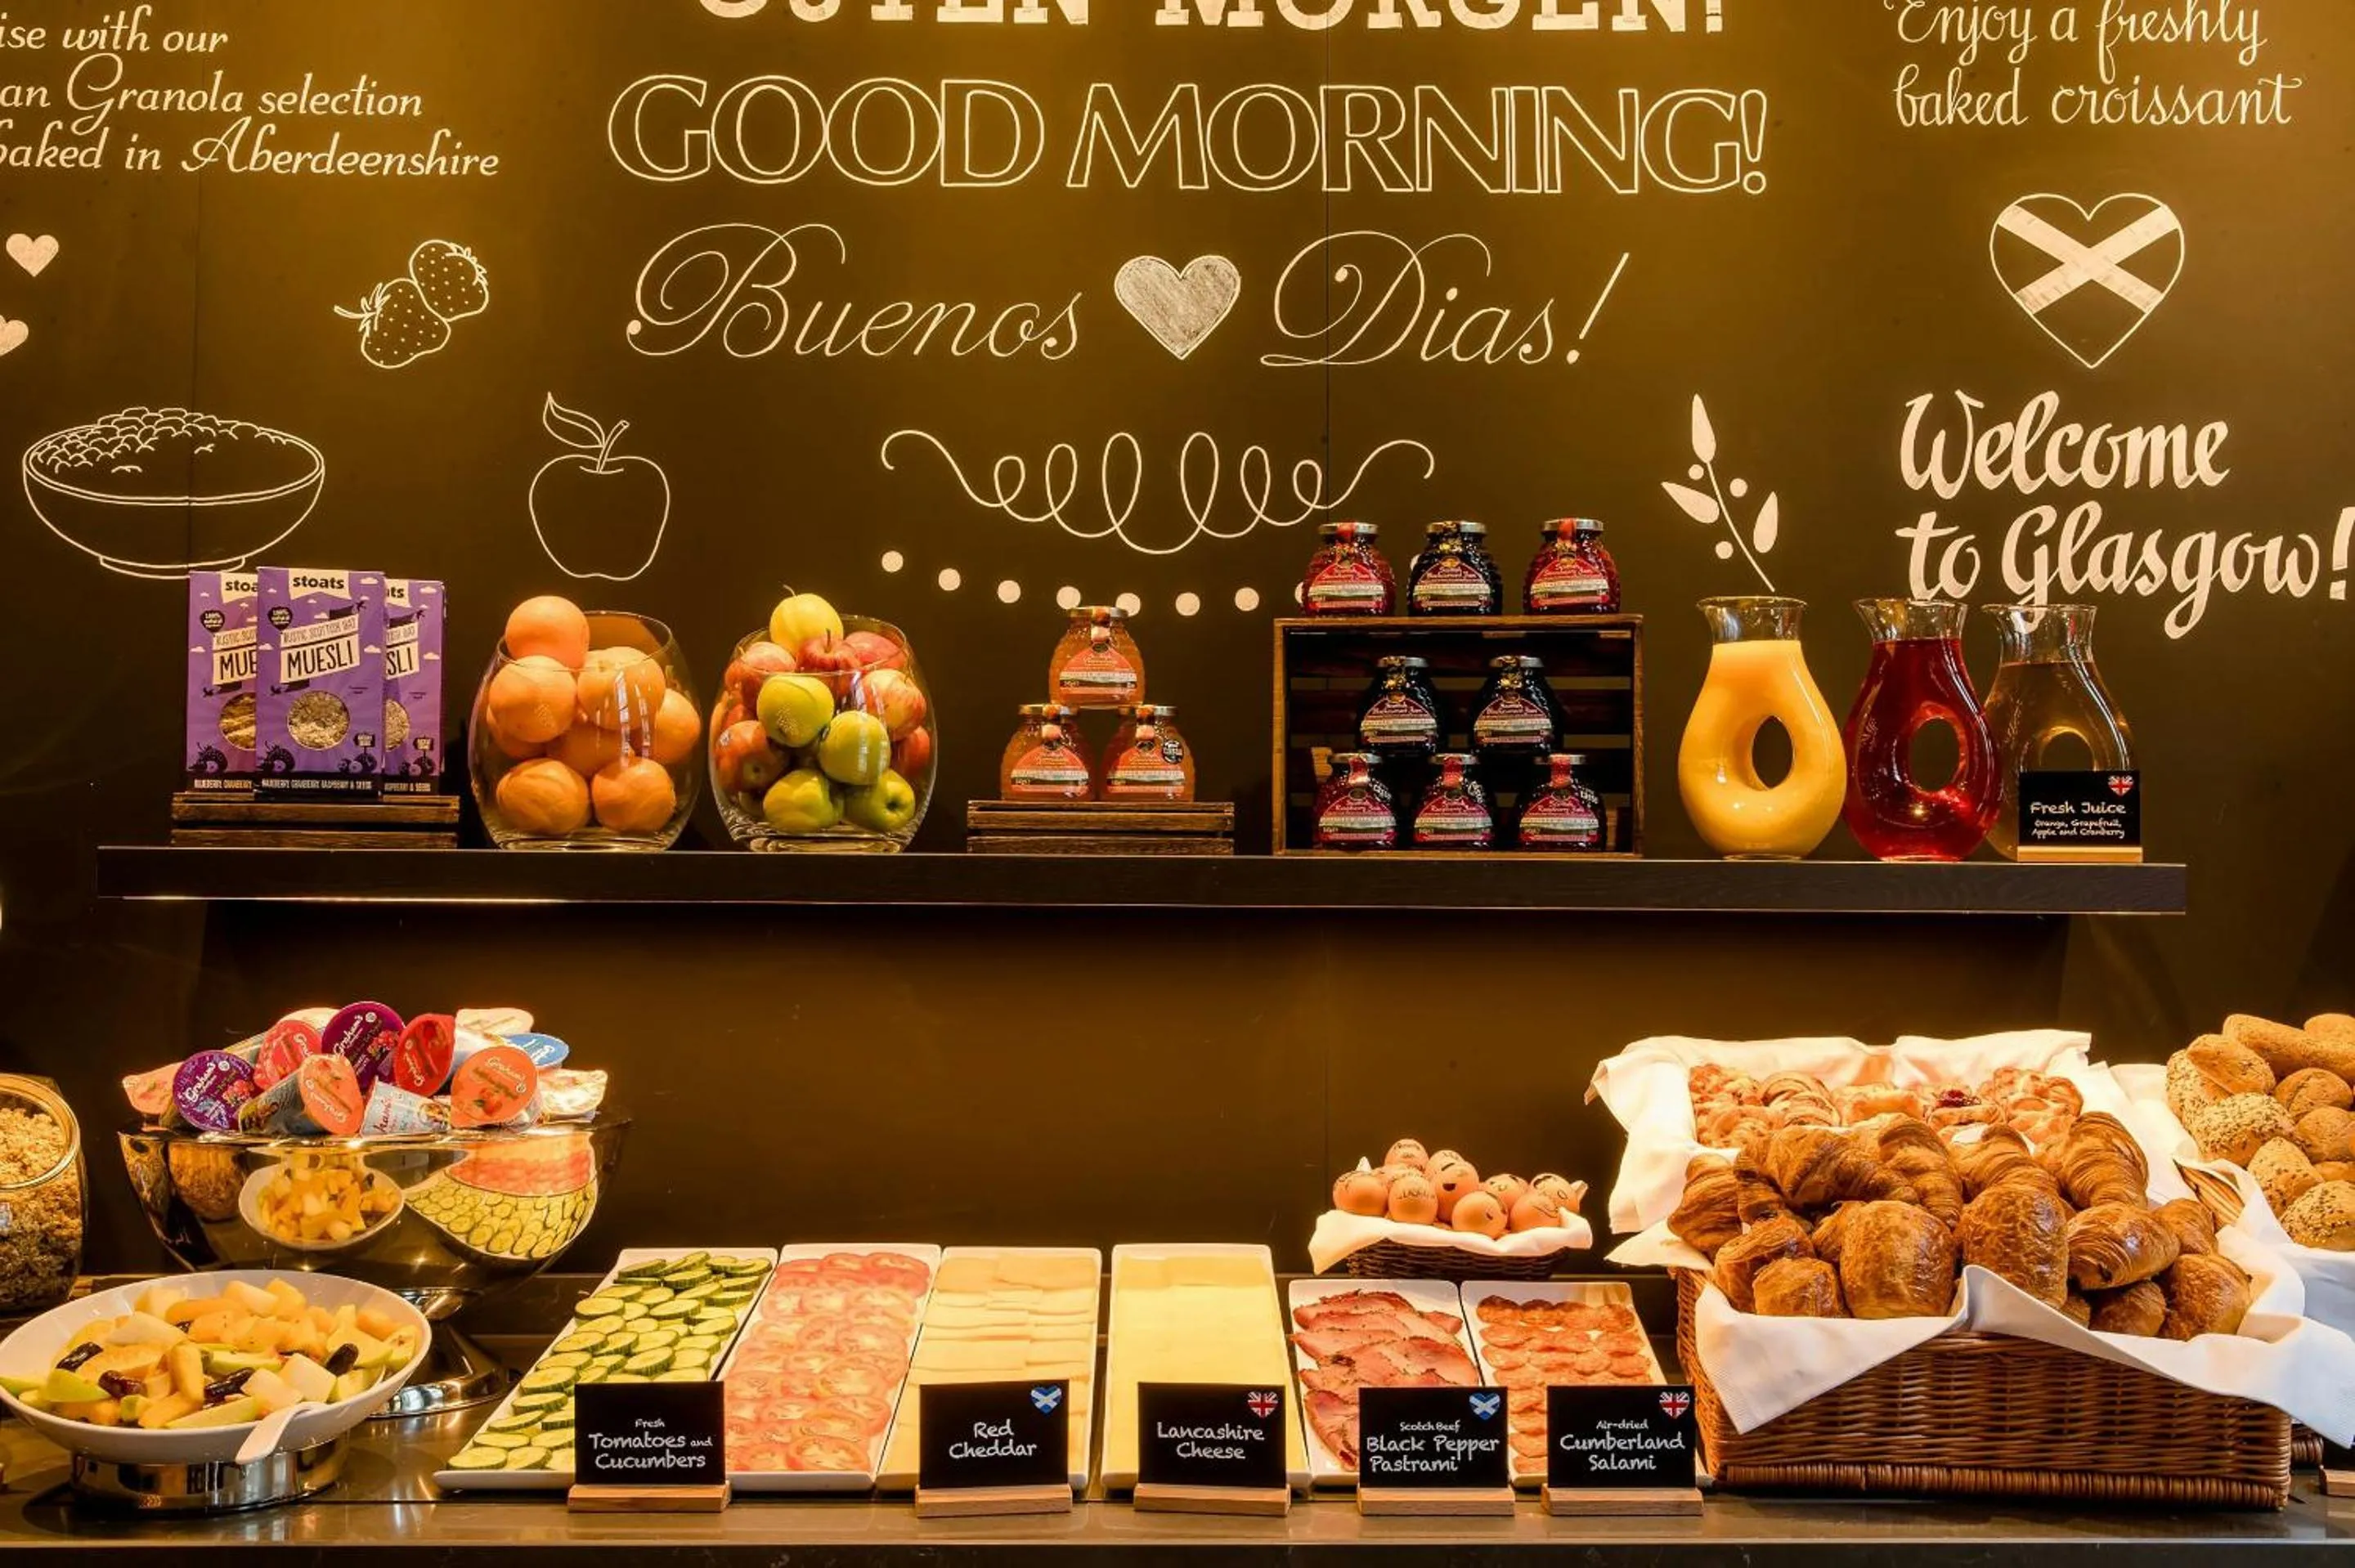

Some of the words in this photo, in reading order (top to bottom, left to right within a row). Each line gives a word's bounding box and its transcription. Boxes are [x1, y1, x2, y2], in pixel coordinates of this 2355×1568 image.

[62, 4, 153, 52] with
[163, 31, 228, 52] our
[1884, 0, 2037, 66] Enjoy
[2049, 2, 2078, 42] a
[2095, 0, 2268, 84] freshly
[67, 52, 244, 136] Granola
[258, 73, 423, 116] selection
[1894, 64, 2029, 128] baked
[2050, 73, 2303, 126] croissant
[608, 74, 1044, 187] GOOD
[1066, 83, 1767, 194] MORNING!
[125, 133, 161, 170] in
[182, 115, 499, 177] Aberdeenshire
[626, 222, 1083, 361] Buenos
[1260, 231, 1629, 366] Dias!
[1900, 389, 2231, 500] Welcome
[1895, 511, 1981, 602] to
[2001, 500, 2355, 639] Glasgow!
[225, 580, 258, 592] stoa
[293, 576, 344, 589] stoats
[220, 649, 257, 680] MUE
[287, 639, 354, 679] MUESLI
[387, 647, 414, 675] SLI
[2030, 800, 2076, 814] Fresh
[2081, 801, 2126, 814] Juice
[2031, 828, 2057, 840] Apple
[2059, 827, 2078, 836] and
[635, 1418, 665, 1428] Fresh
[973, 1418, 1014, 1439] Red
[1157, 1422, 1265, 1440] Lancashire
[1400, 1421, 1434, 1432] Scotch
[1435, 1419, 1461, 1433] Beef
[1596, 1418, 1648, 1430] Air-dried
[588, 1431, 686, 1449] Tomatoes
[690, 1436, 713, 1447] and
[949, 1439, 1037, 1459] Cheddar
[1176, 1440, 1246, 1459] Cheese
[1366, 1434, 1426, 1453] Black
[1433, 1434, 1500, 1462] Pepper
[1559, 1431, 1686, 1451] Cumberland
[594, 1449, 706, 1470] Cucumbers
[1369, 1454, 1458, 1472] Pastrami
[1588, 1453, 1657, 1471] Salami
